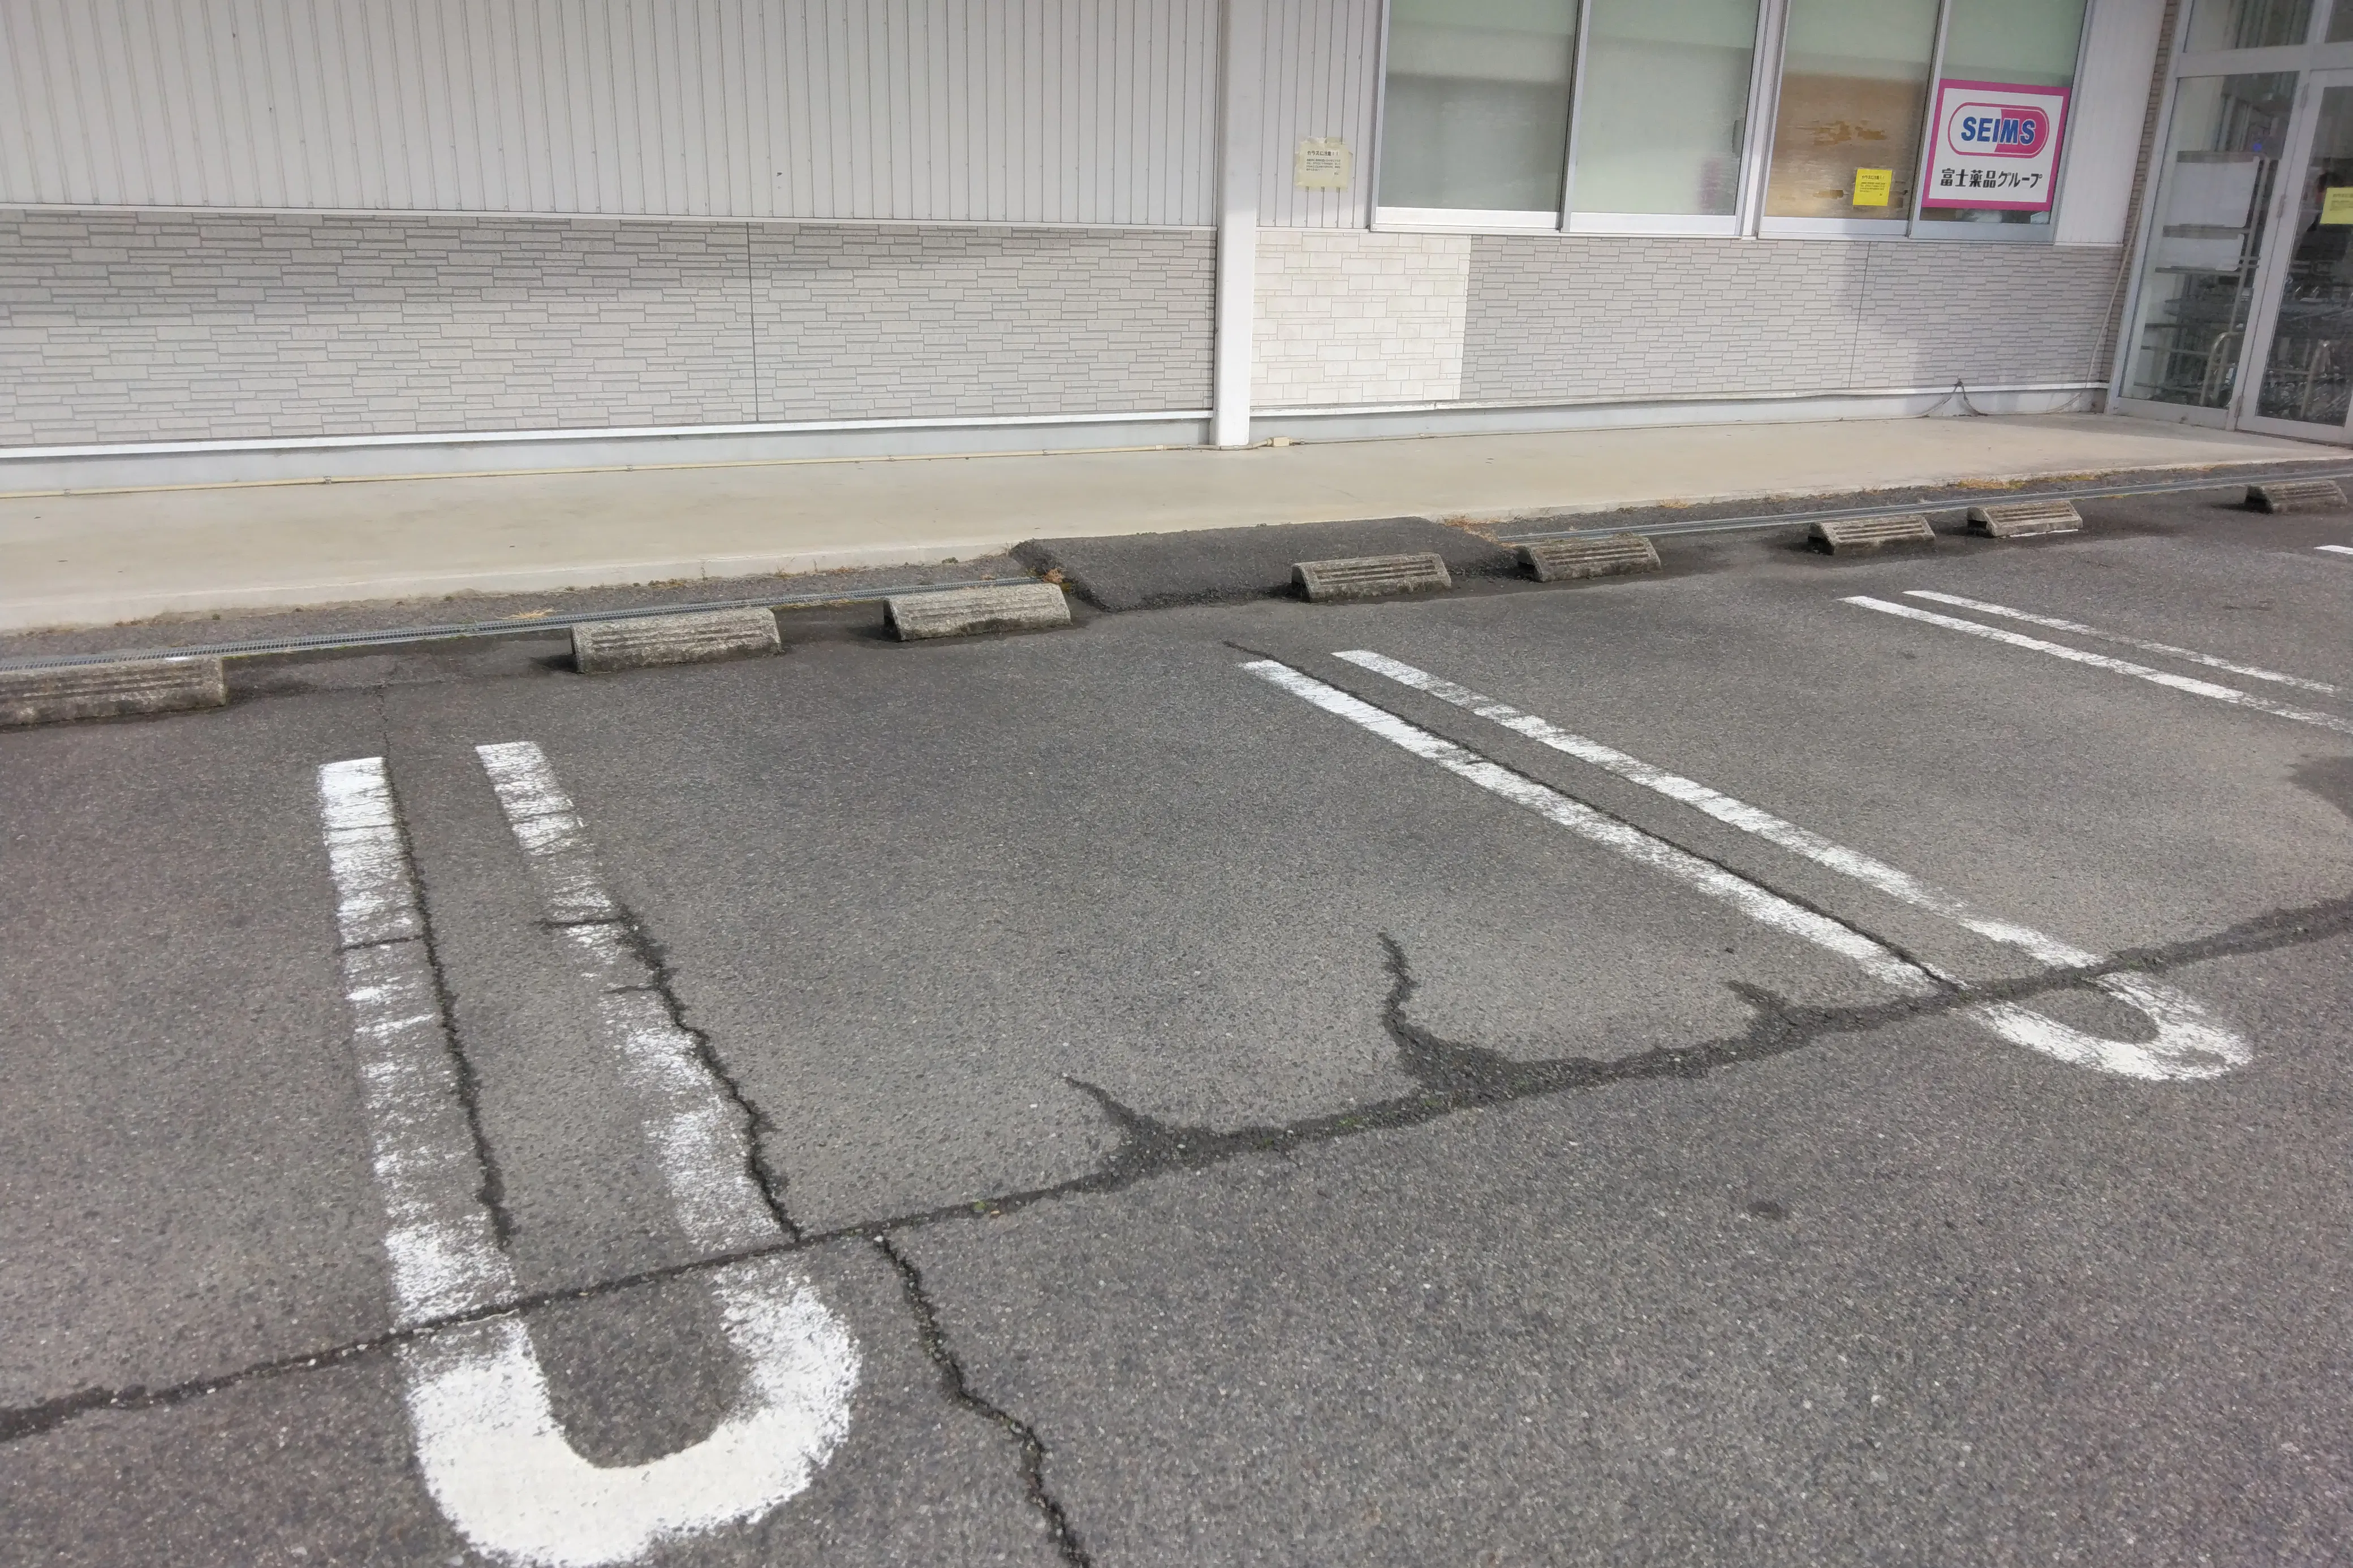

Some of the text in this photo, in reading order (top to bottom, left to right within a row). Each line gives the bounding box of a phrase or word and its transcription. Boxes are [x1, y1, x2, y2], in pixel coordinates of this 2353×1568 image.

[1961, 116, 2036, 145] SEIMS
[1940, 168, 2043, 189] 富士薬品グループ
